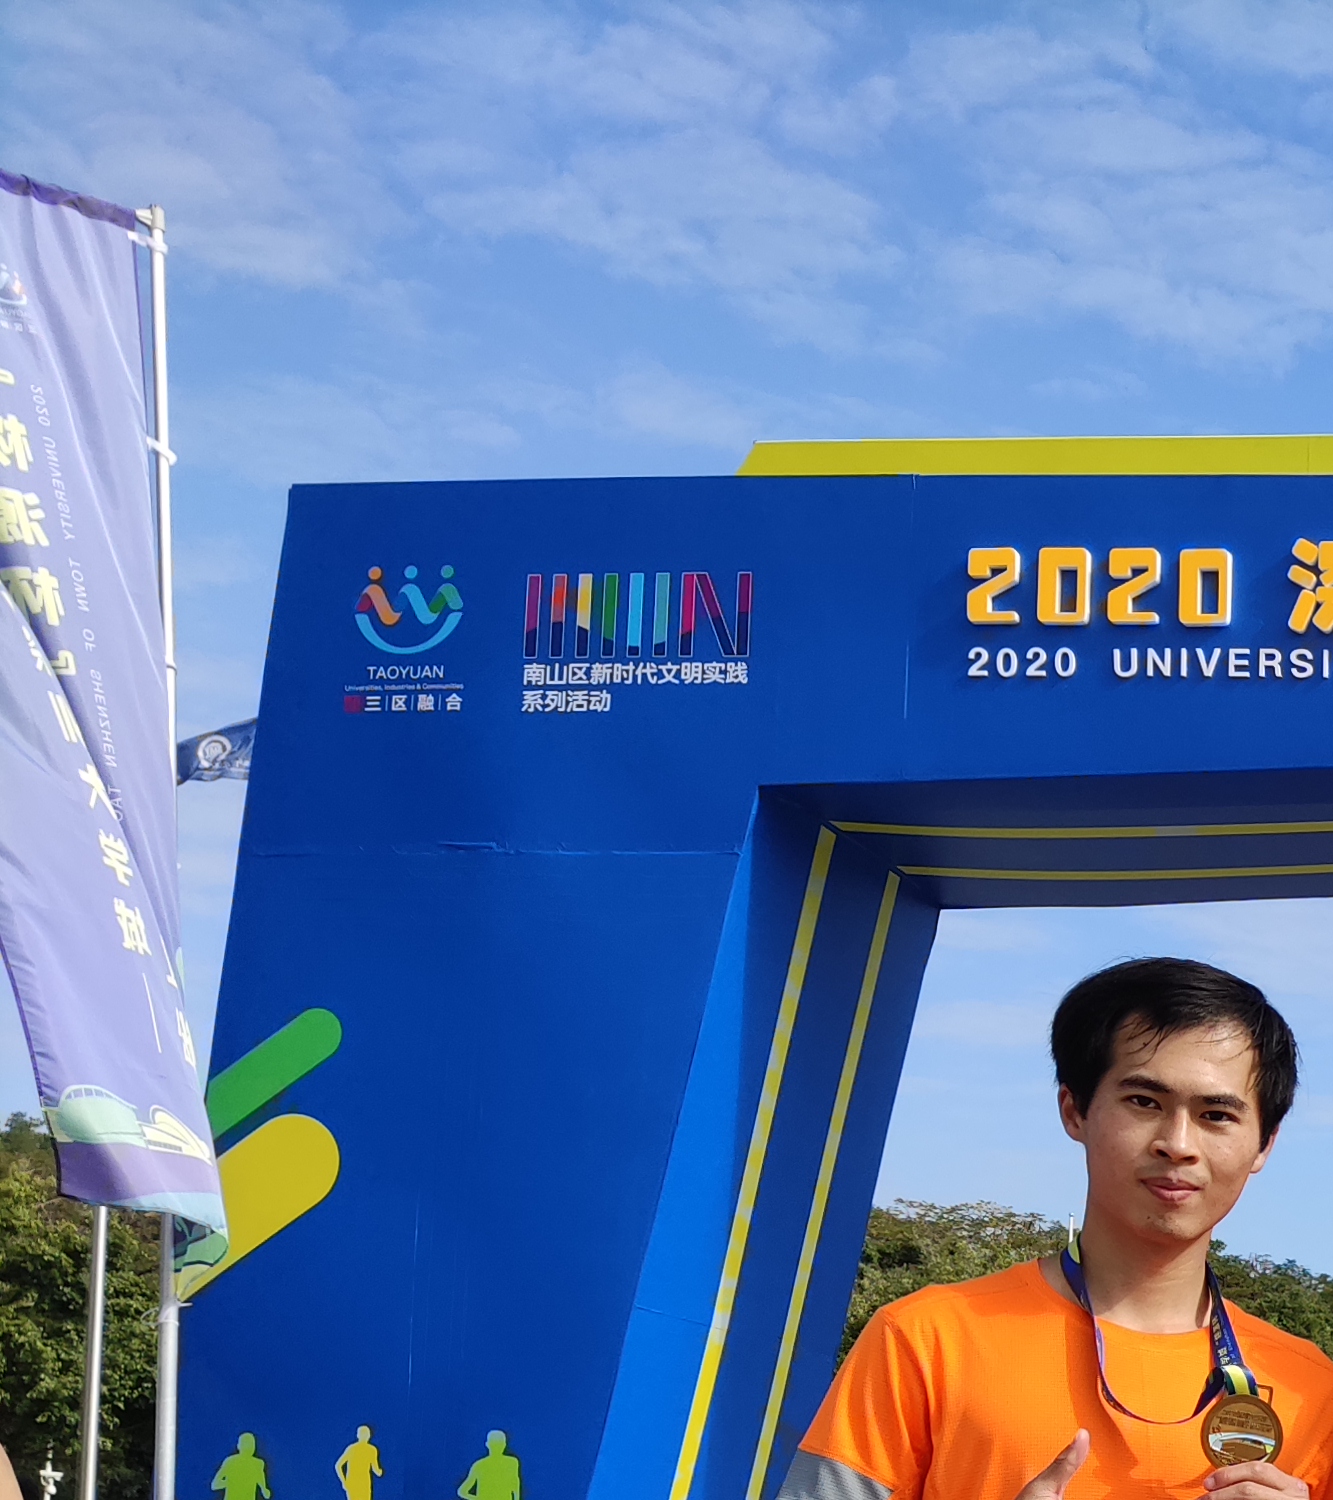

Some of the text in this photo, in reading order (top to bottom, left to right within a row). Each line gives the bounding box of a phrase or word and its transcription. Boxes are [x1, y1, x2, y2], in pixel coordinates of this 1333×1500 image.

[966, 547, 1232, 627] 2020
[366, 665, 445, 680] TAOYUAN
[522, 662, 749, 687] 南山区新时代文明实践
[967, 647, 1078, 679] 2020
[521, 690, 611, 714] 系列活动
